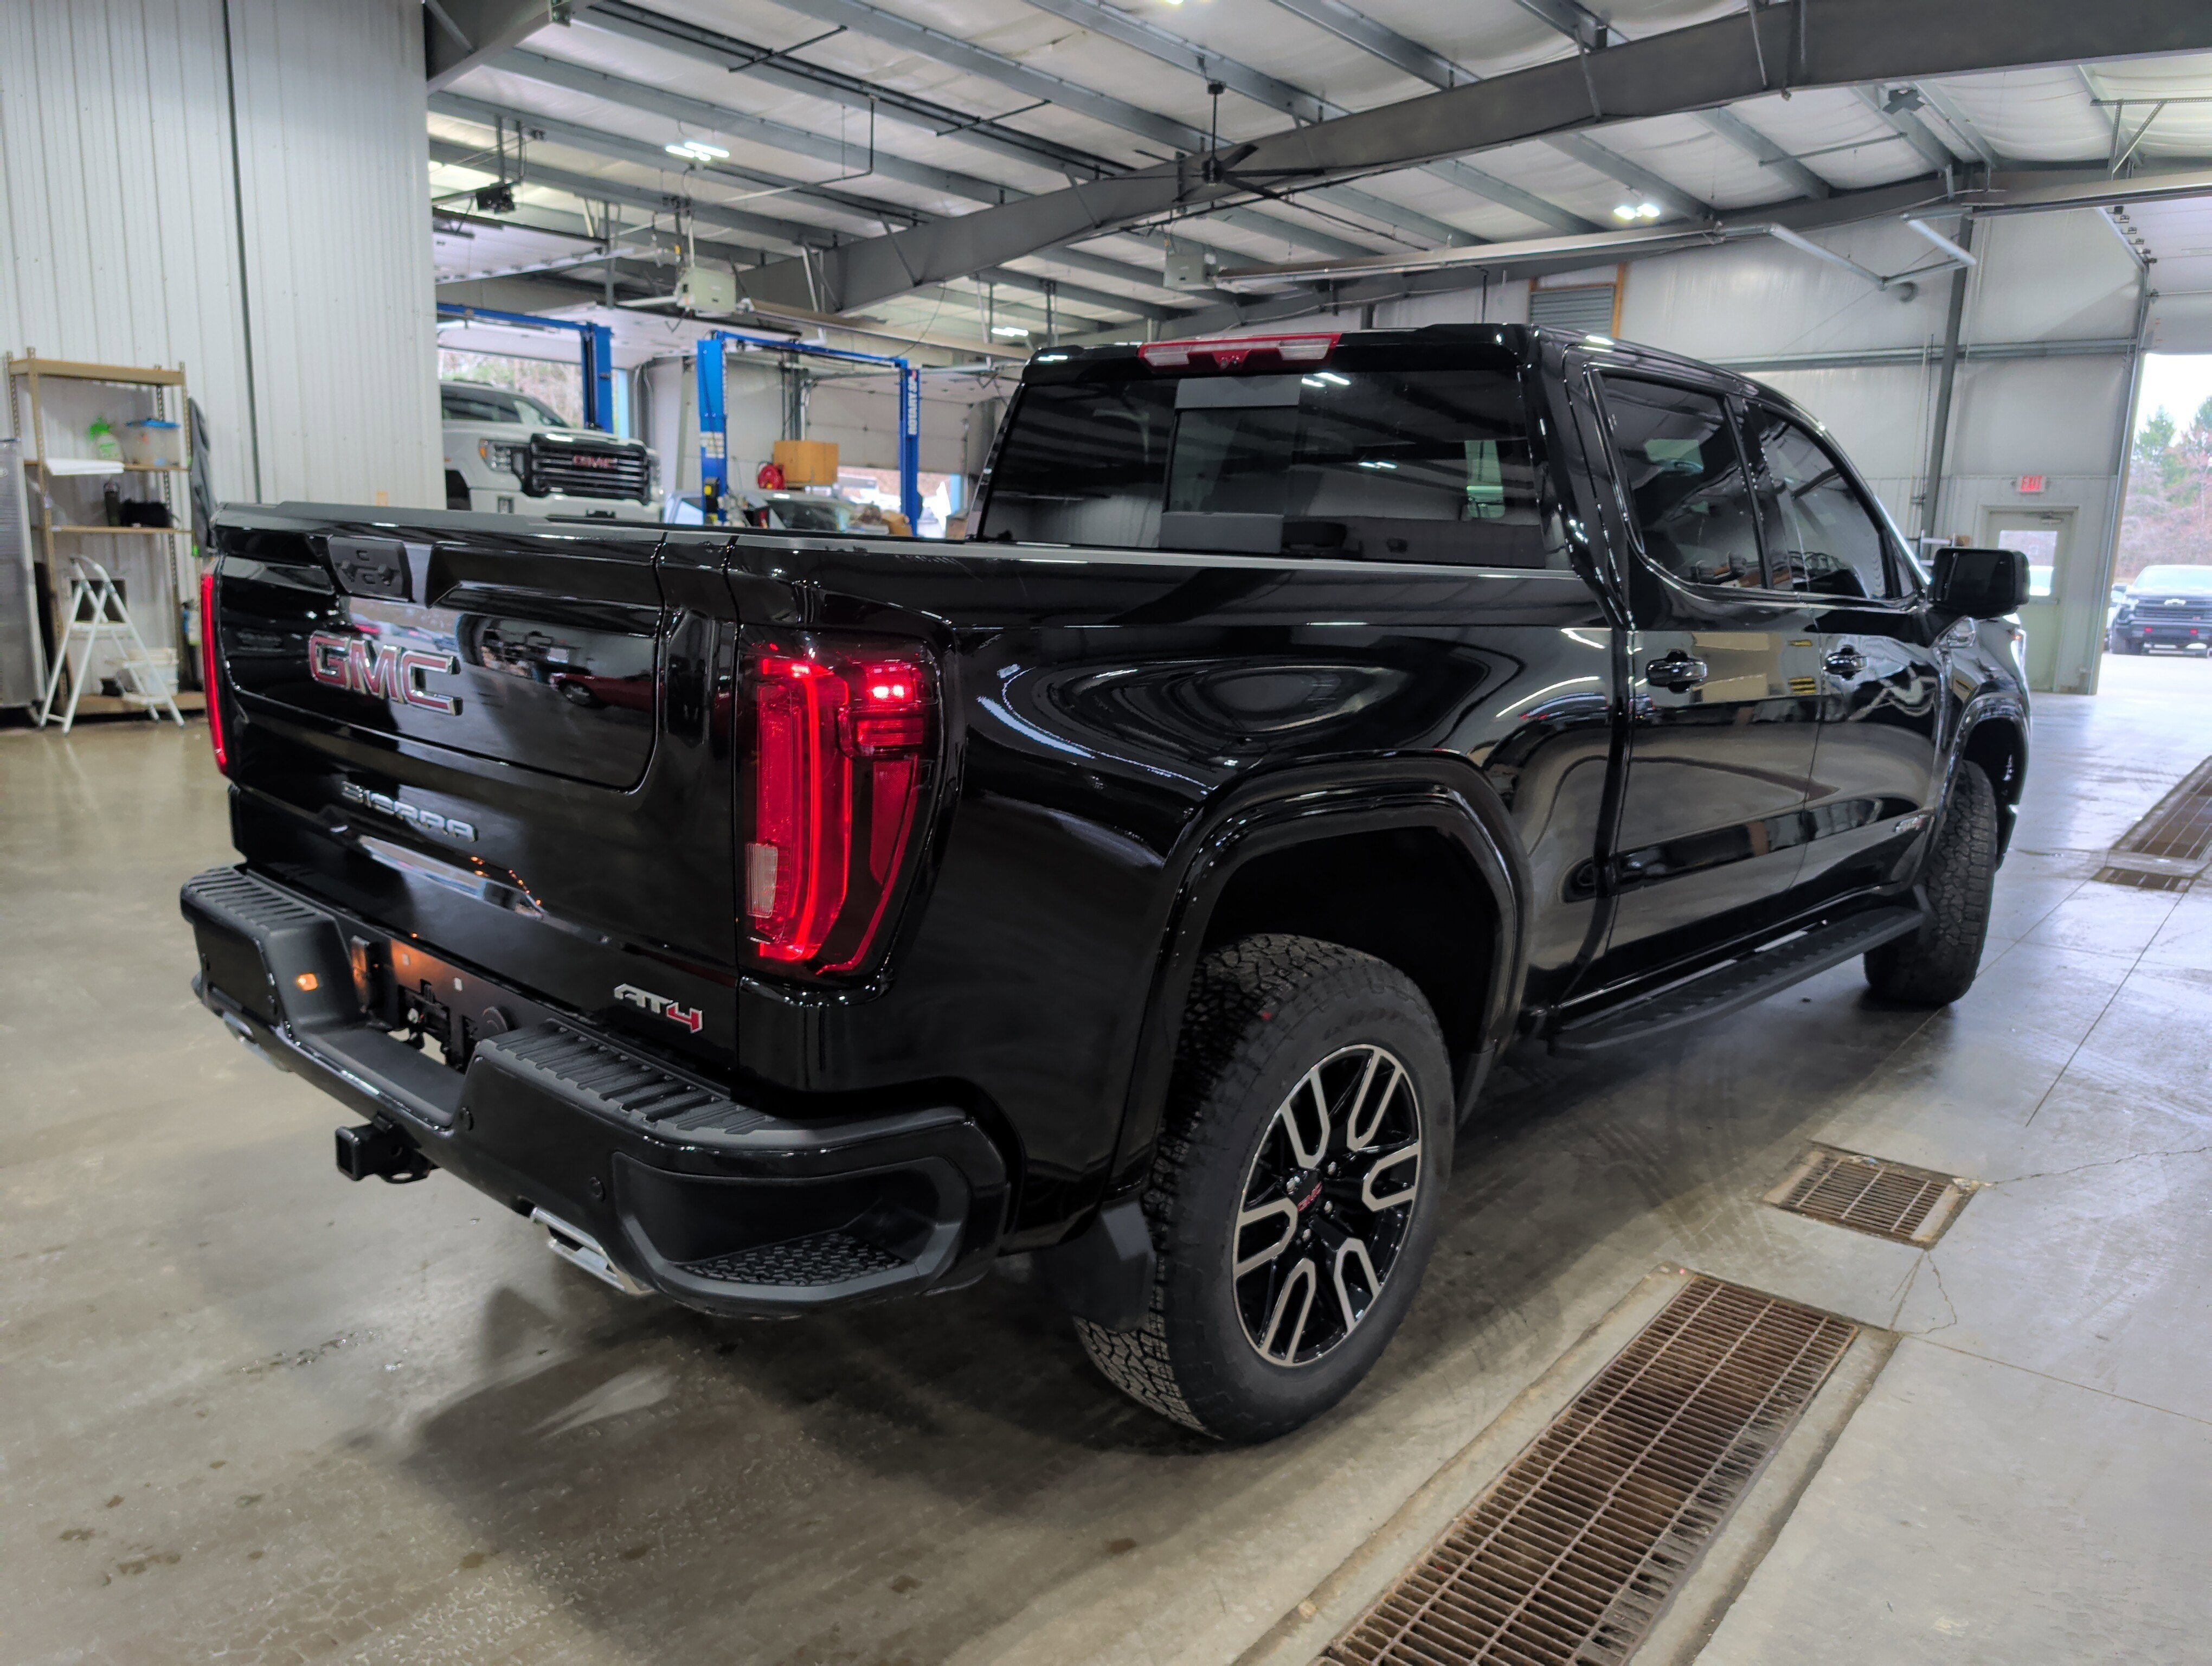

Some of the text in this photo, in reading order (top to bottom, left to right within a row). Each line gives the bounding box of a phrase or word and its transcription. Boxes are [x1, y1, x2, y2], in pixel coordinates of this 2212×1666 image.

[573, 454, 618, 470] GMC
[2021, 476, 2043, 491] EXIT
[308, 630, 464, 716] GMC
[341, 780, 479, 842] SIERRA
[614, 983, 703, 1034] AT4
[1297, 1181, 1323, 1212] GMC
